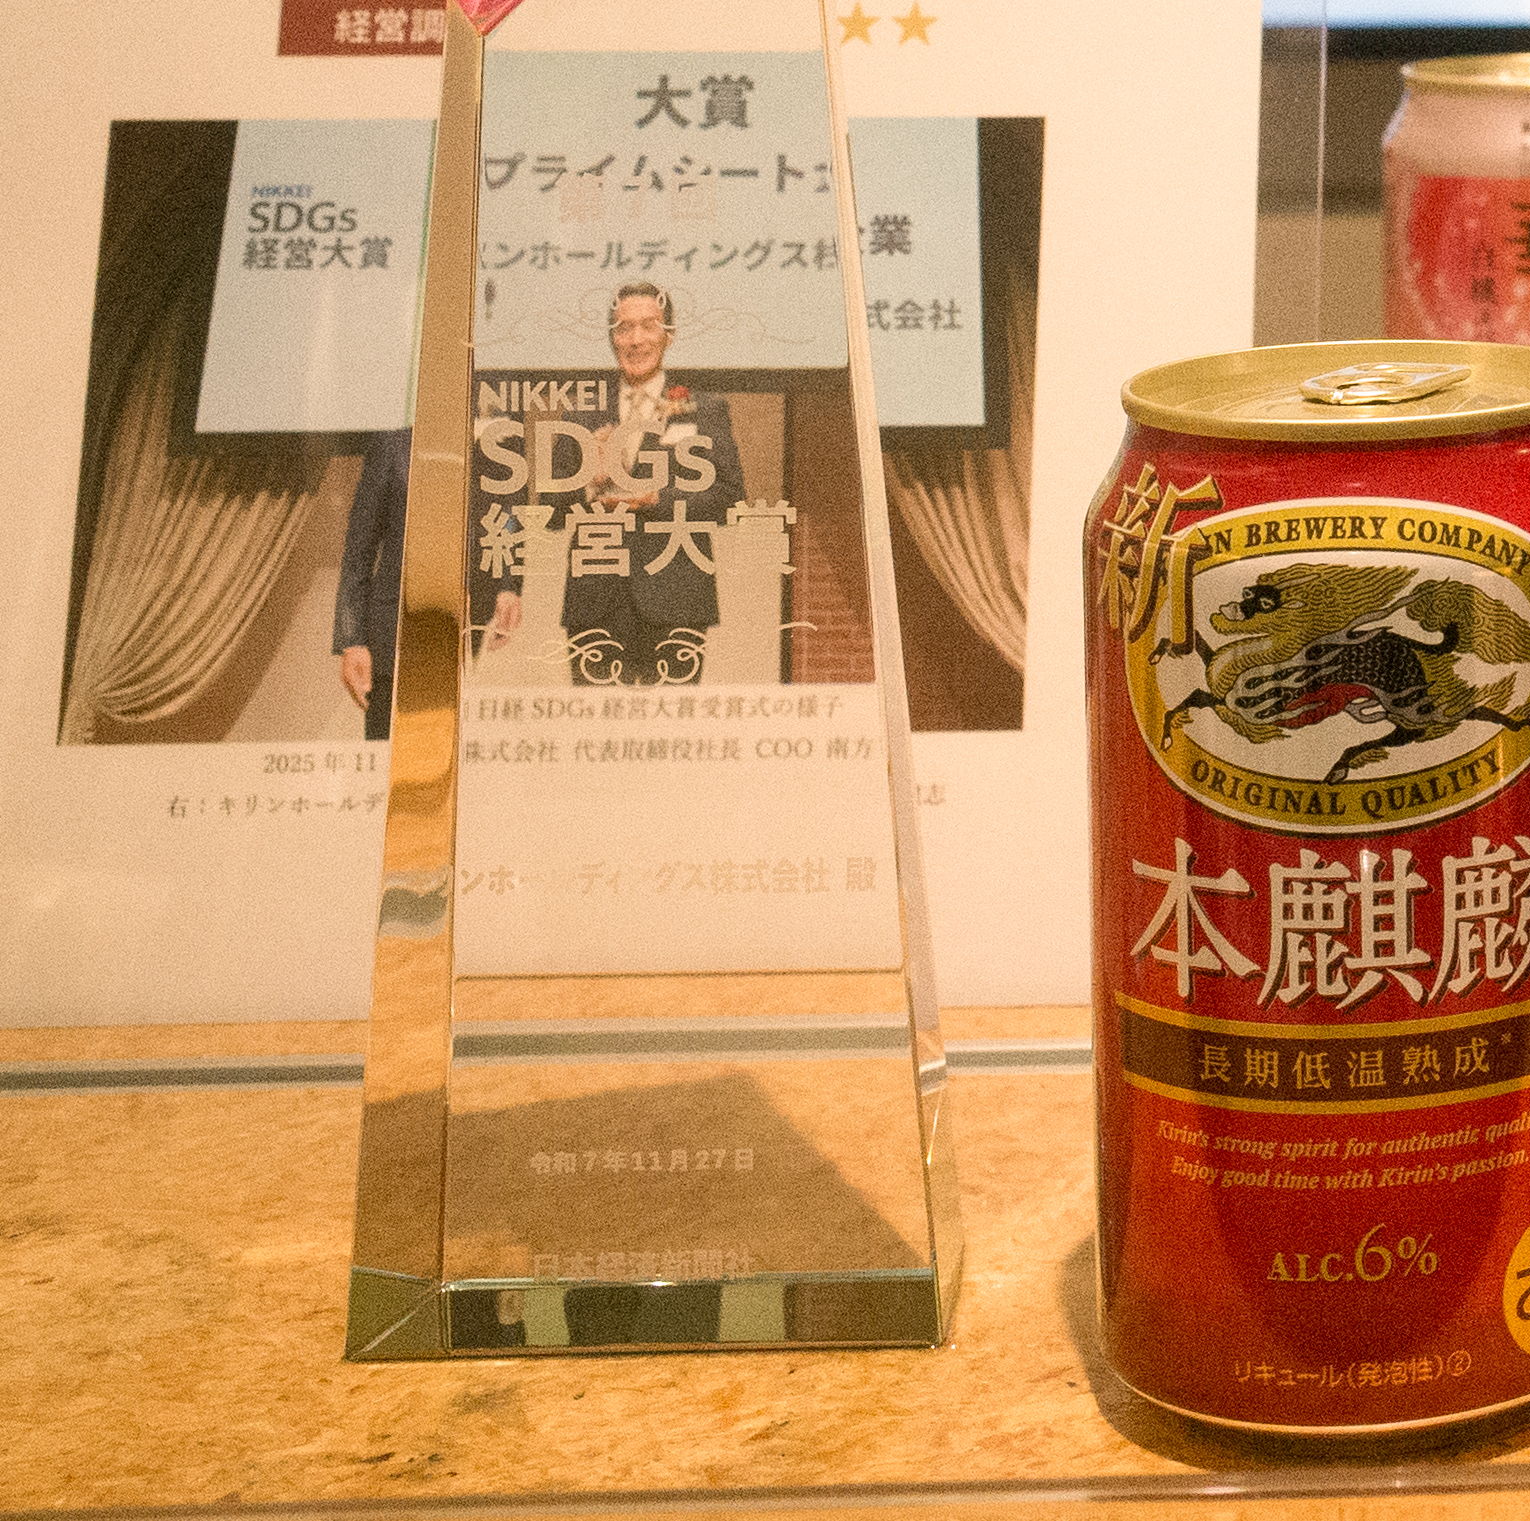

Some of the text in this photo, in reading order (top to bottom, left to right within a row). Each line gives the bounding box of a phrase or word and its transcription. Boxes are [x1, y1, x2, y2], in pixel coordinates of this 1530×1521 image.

[635, 74, 754, 130] 大賞
[248, 202, 358, 234] SDGs
[858, 213, 914, 255] 業
[242, 236, 393, 271] 経営大賞
[479, 380, 608, 412] NIKKEI
[479, 420, 716, 495] SDGs
[479, 499, 798, 579] 経営大賞
[1246, 515, 1384, 548] BREWERY
[1097, 460, 1225, 655] 新
[755, 739, 813, 760] COO
[1190, 747, 1503, 819] ORIGINAL QUALITY
[1213, 1136, 1275, 1159] strong
[1281, 1136, 1337, 1160] spirit
[1342, 1136, 1377, 1160] for
[1381, 1127, 1479, 1156] authentic
[530, 1149, 755, 1175] 令和7年11月27日
[1171, 1155, 1216, 1186] Enjoy
[1221, 1167, 1271, 1189] good
[1273, 1168, 1321, 1189] time
[1325, 1168, 1373, 1189] with
[1377, 1161, 1447, 1188] Kirin's
